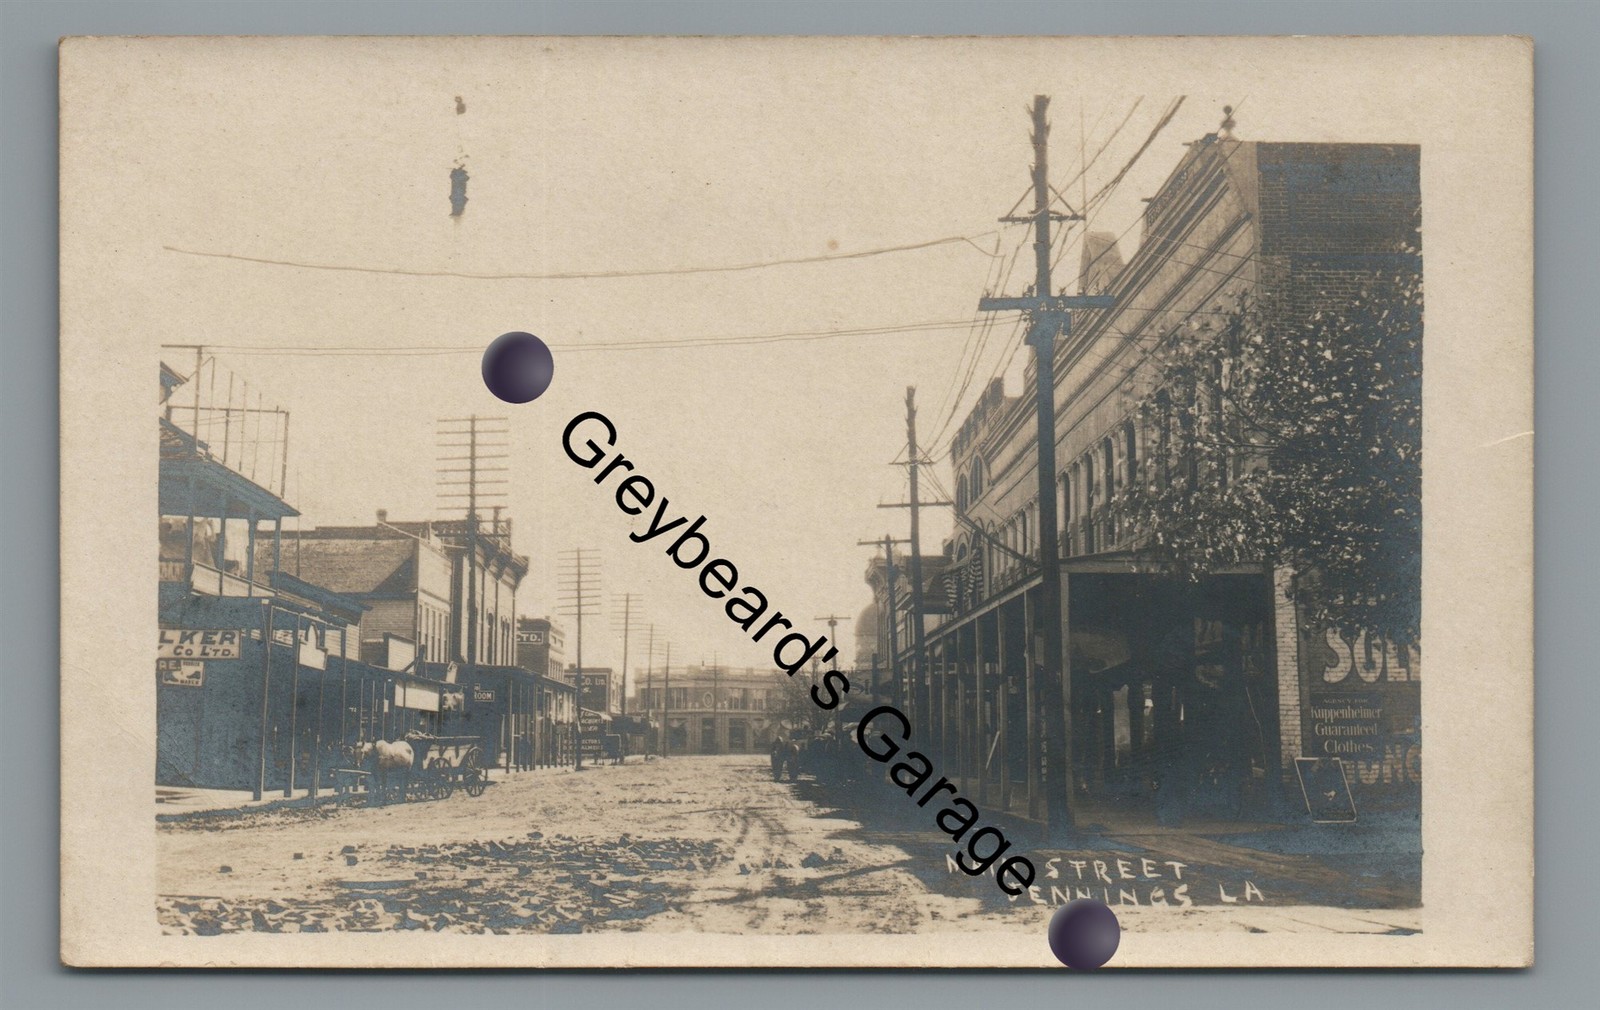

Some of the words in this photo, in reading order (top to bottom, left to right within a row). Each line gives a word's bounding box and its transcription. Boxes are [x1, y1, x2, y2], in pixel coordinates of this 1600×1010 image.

[1311, 705, 1383, 723] Kuppenheimer
[1315, 722, 1378, 736] Guaranteed
[1324, 739, 1374, 753] Clothes
[1045, 858, 1188, 884] STREET
[1219, 880, 1265, 903] LA
